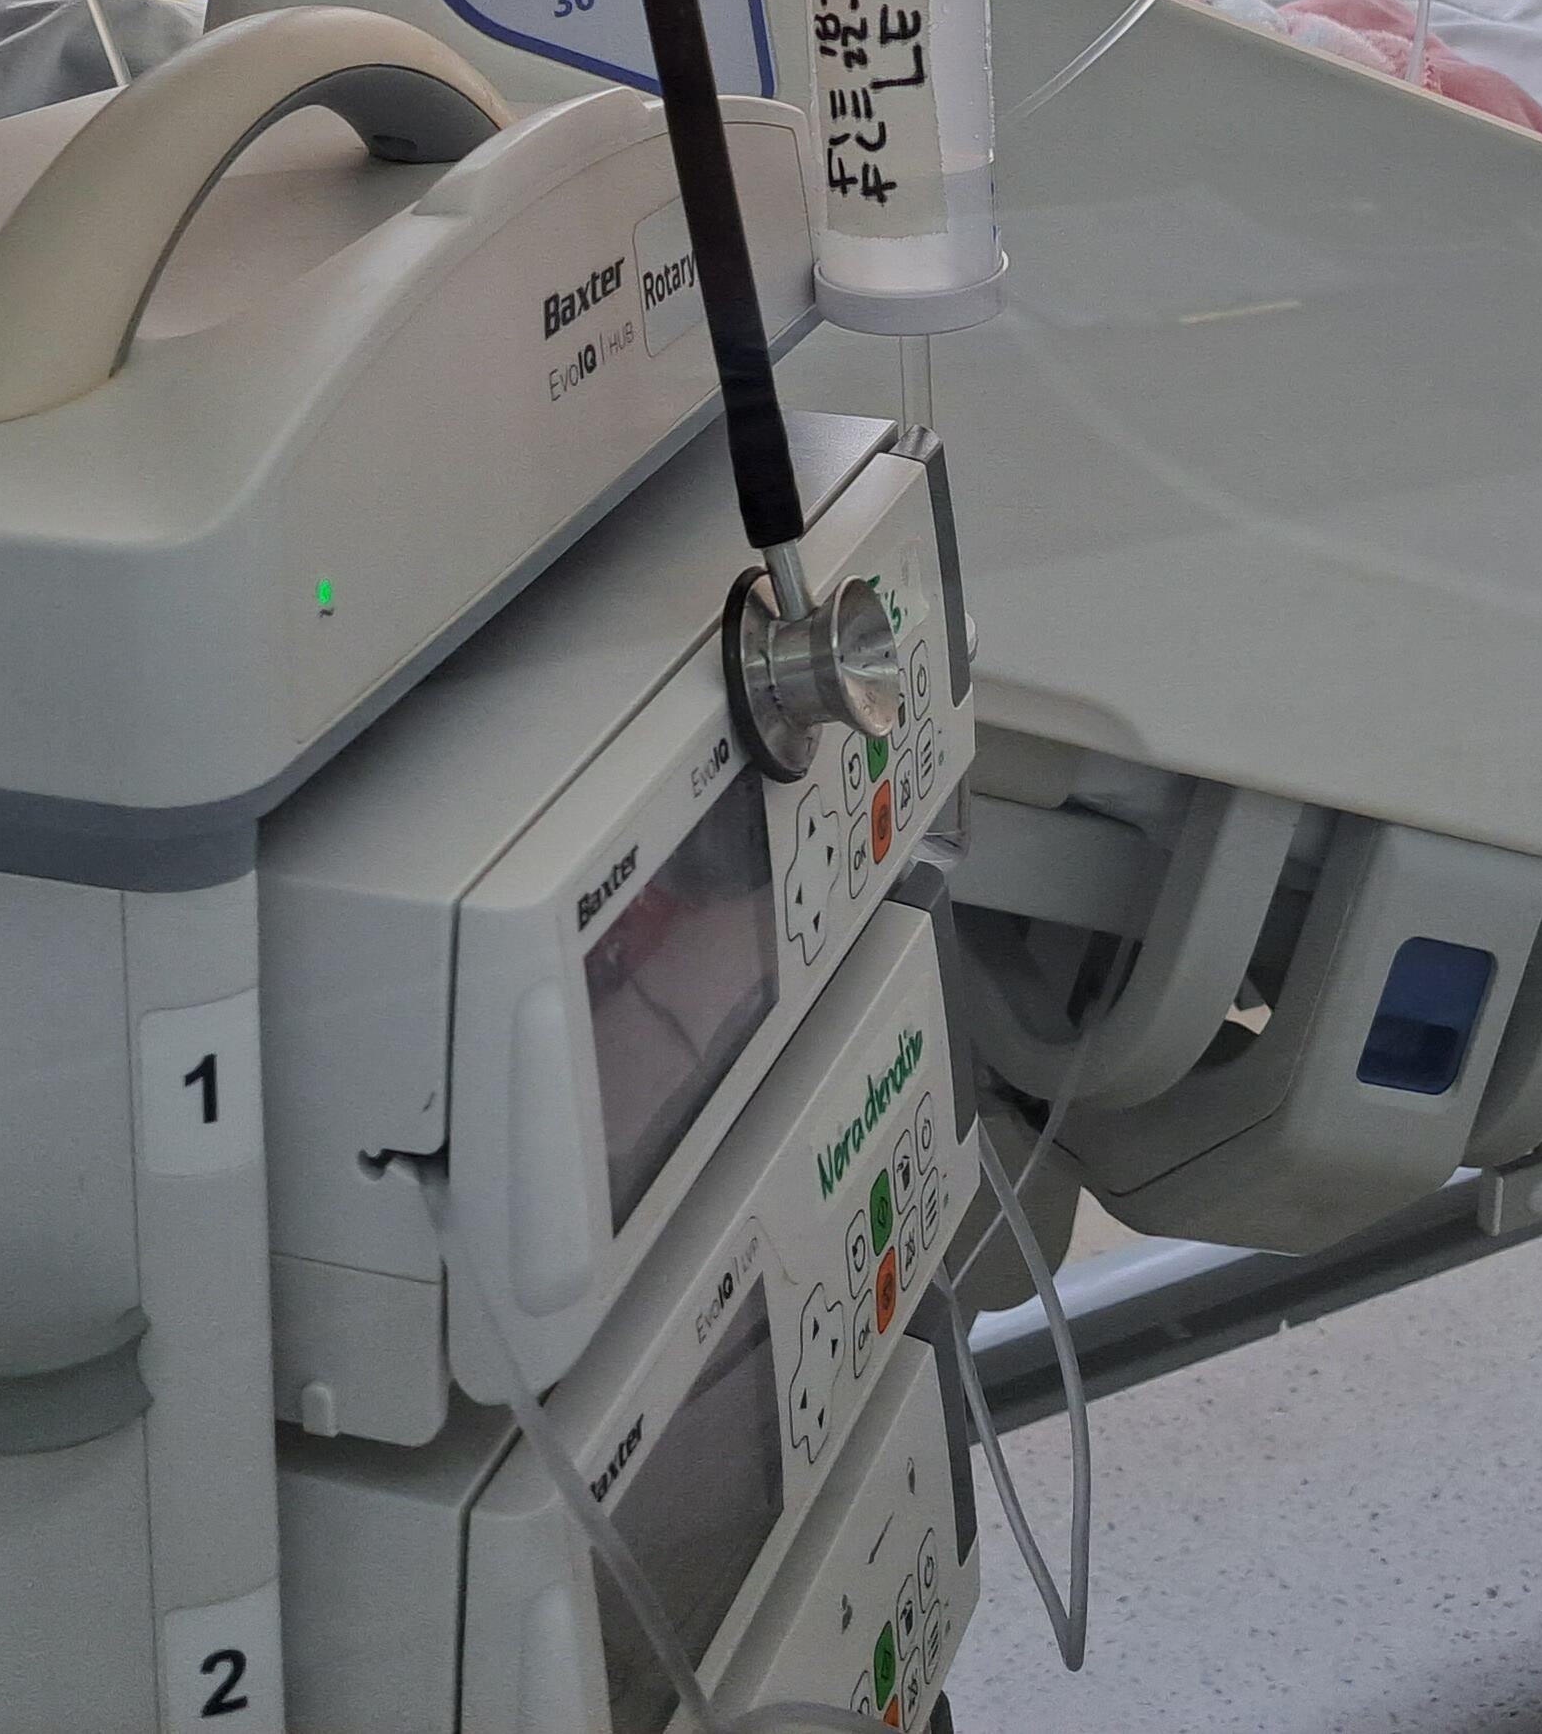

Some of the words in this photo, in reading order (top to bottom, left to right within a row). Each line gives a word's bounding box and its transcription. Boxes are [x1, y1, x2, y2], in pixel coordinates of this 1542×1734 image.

[543, 257, 626, 341] Baxter
[642, 248, 697, 311] Rotary
[548, 343, 598, 402] EvoIQ
[608, 321, 635, 356] HUB
[577, 844, 639, 932] Baxter
[183, 1053, 219, 1125] 1
[589, 1413, 645, 1503] axter
[200, 1648, 249, 1719] 2
